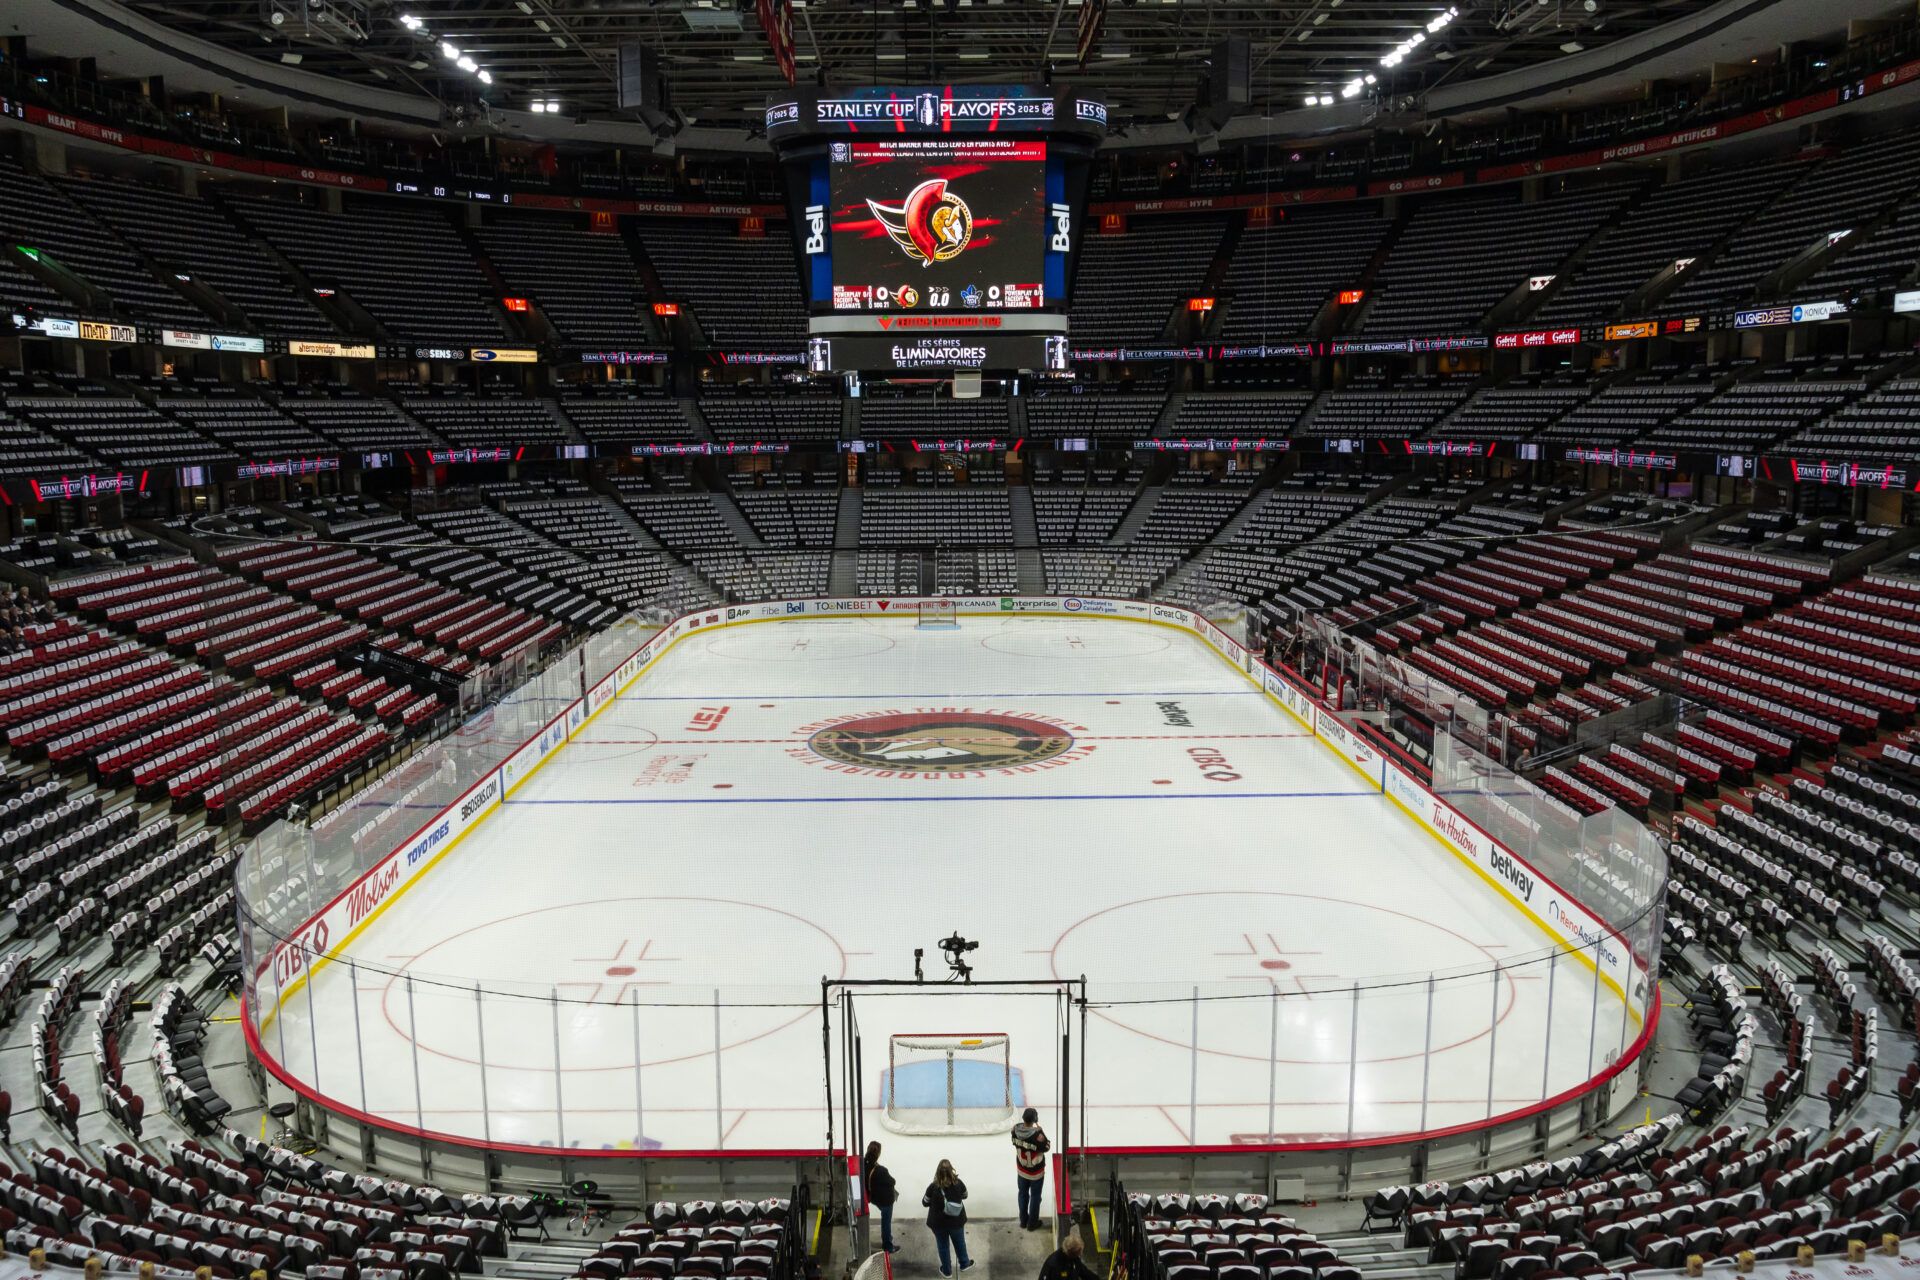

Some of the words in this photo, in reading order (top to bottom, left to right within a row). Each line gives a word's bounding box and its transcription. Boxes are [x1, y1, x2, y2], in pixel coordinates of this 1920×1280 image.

[1882, 72, 1896, 85] GO
[817, 103, 881, 119] STANLEY
[881, 103, 915, 118] CUP
[940, 102, 1016, 119] PLAYOFFS
[1018, 105, 1040, 115] 2025
[1076, 103, 1095, 117] LES
[48, 114, 76, 131] HEART
[101, 129, 122, 143] HYPE
[1603, 149, 1615, 159] DU
[1617, 143, 1645, 157] COEUR
[1671, 127, 1718, 145] ARTIFICES
[301, 169, 315, 179] GO
[341, 175, 353, 185] GO
[1389, 182, 1403, 191] GO
[1428, 177, 1442, 186] GO
[639, 203, 652, 212] DU
[653, 203, 683, 213] COEUR
[709, 205, 752, 215] ARTIFICES
[1135, 202, 1164, 211] HEART
[1189, 199, 1213, 208] HYPE
[806, 205, 824, 254] Bell
[1051, 203, 1070, 252] Bell
[876, 286, 889, 300] 0
[929, 292, 950, 307] 0.0
[988, 286, 1000, 300] 0
[1735, 312, 1768, 325] ALIGNED
[1804, 307, 1828, 317] KONICA
[52, 323, 71, 331] CALIAN
[1495, 335, 1518, 346] Gabriel
[1523, 332, 1546, 342] Gabriel
[1552, 330, 1575, 340] Gabriel
[918, 339, 931, 348] LES
[933, 338, 961, 348] SÉRIES
[1364, 342, 1407, 351] ÉLIMINATOIRES
[757, 353, 799, 362] ÉLIMINATOIRES
[892, 345, 986, 360] ÉLIMINATOIRES
[1074, 350, 1117, 358] ÉLIMINATOIRES
[1721, 458, 1729, 467] 20
[1744, 459, 1752, 469] 25
[1797, 467, 1825, 477] STANLEY
[1825, 470, 1839, 479] CUP
[1850, 473, 1887, 482] PLAYOFFS
[39, 484, 67, 496] STANLEY
[68, 482, 81, 493] CUP
[90, 479, 121, 490] PLAYOFFS
[762, 607, 780, 615] Fibe
[787, 602, 805, 613] Bell
[1153, 607, 1174, 619] Great
[1175, 610, 1188, 623] Clips
[1155, 701, 1195, 728] betway
[1433, 803, 1447, 833] Tim
[1446, 813, 1478, 858] Hortons
[407, 838, 428, 867] TOYO
[428, 819, 450, 849] TIRES
[1490, 844, 1534, 902] betway
[346, 860, 399, 928] Molson
[278, 931, 312, 988] CIBC
